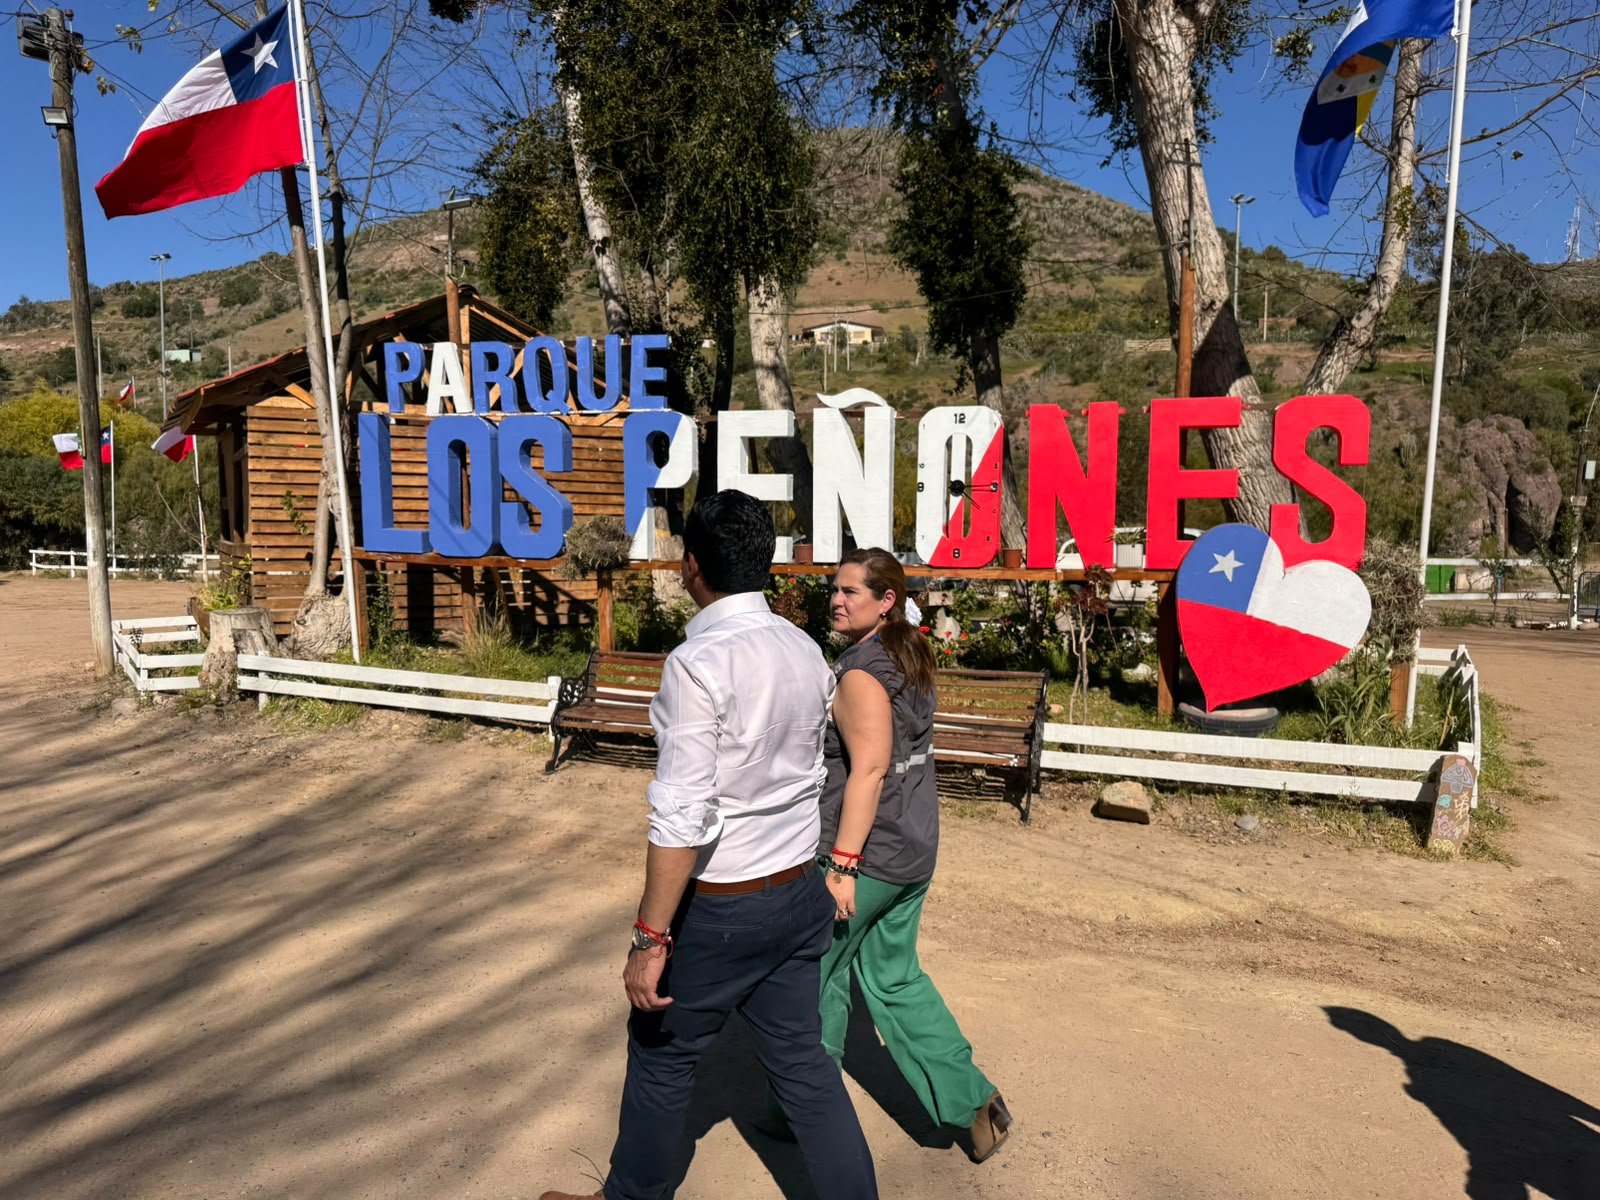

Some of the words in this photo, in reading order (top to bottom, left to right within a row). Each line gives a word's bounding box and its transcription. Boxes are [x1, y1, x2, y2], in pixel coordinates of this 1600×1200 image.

[384, 334, 671, 415] PARQUE
[953, 413, 966, 424] 12
[359, 411, 573, 559] LOS
[623, 387, 1370, 570] PEÑONES
